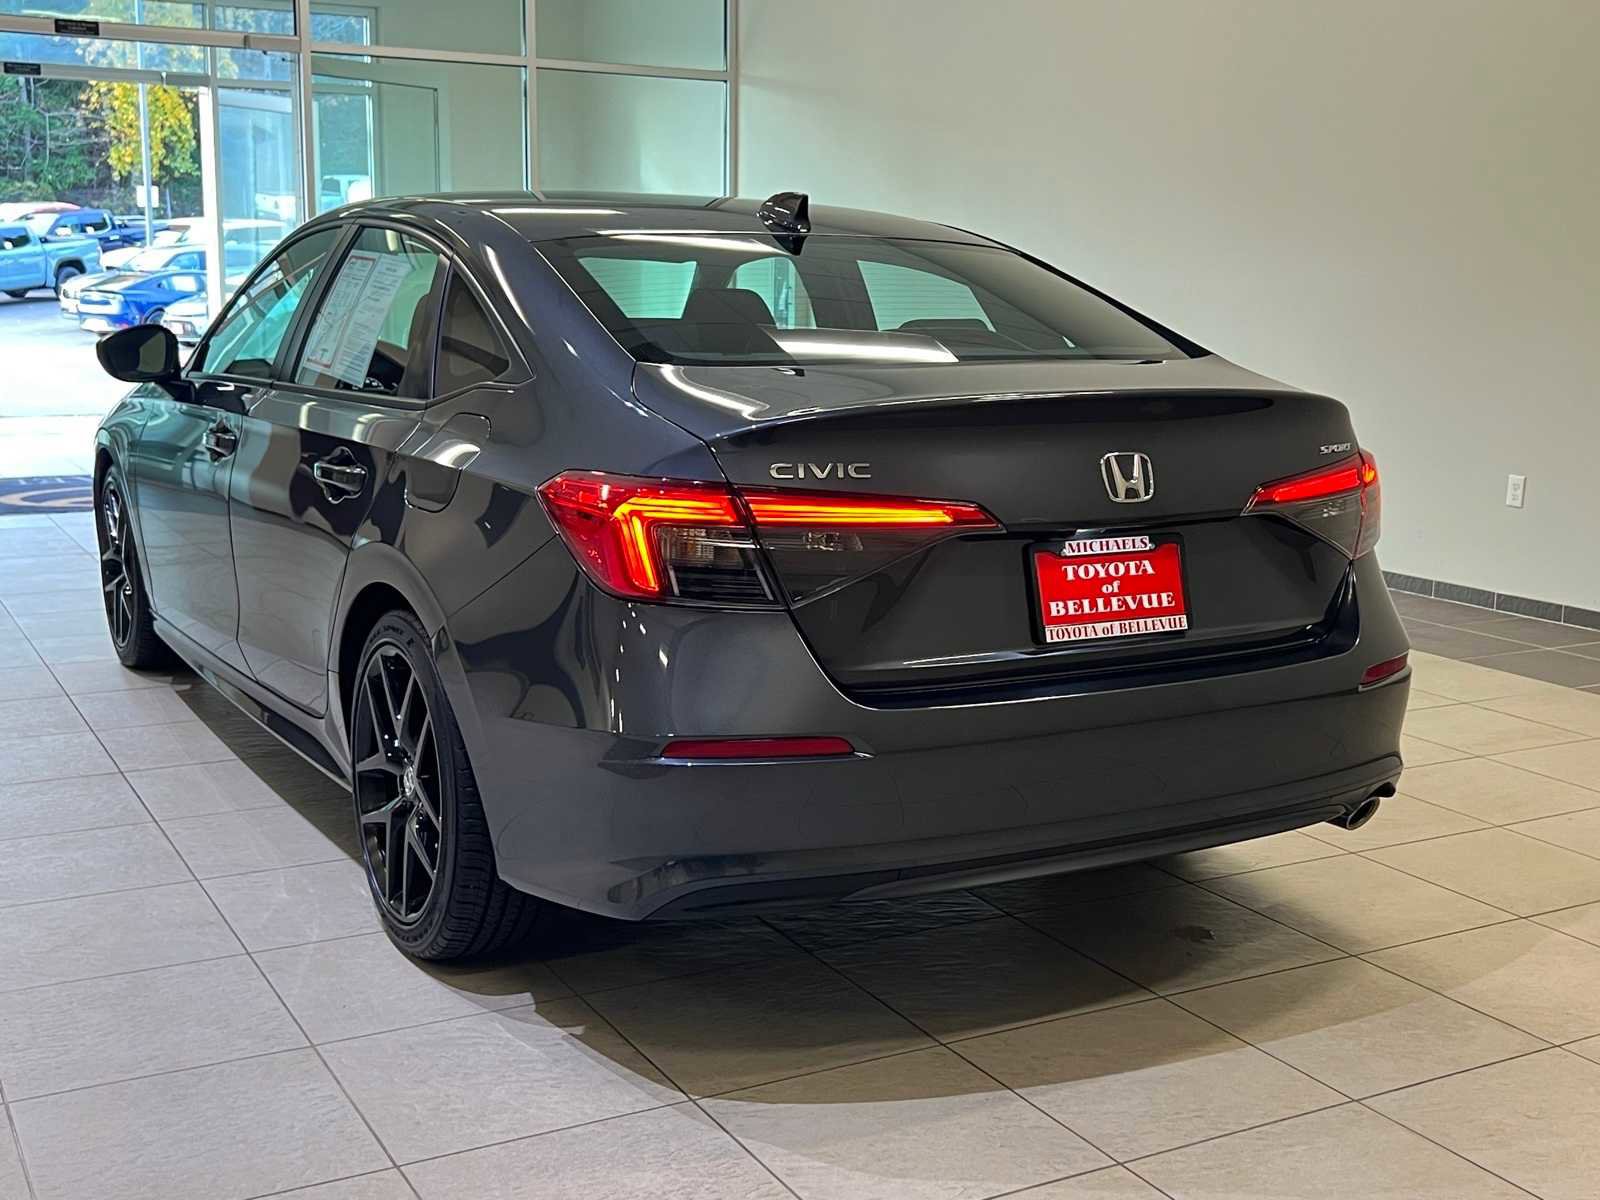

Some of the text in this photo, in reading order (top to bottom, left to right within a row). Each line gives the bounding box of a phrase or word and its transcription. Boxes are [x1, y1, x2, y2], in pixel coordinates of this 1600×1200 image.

[769, 463, 872, 478] CIVIC
[1066, 537, 1149, 554] MICHAELS
[1062, 560, 1155, 581] TOYOTA
[1101, 580, 1120, 594] of
[1048, 592, 1176, 617] BELLEVUE
[1047, 617, 1187, 641] TOYOTA of BELLEVUE
